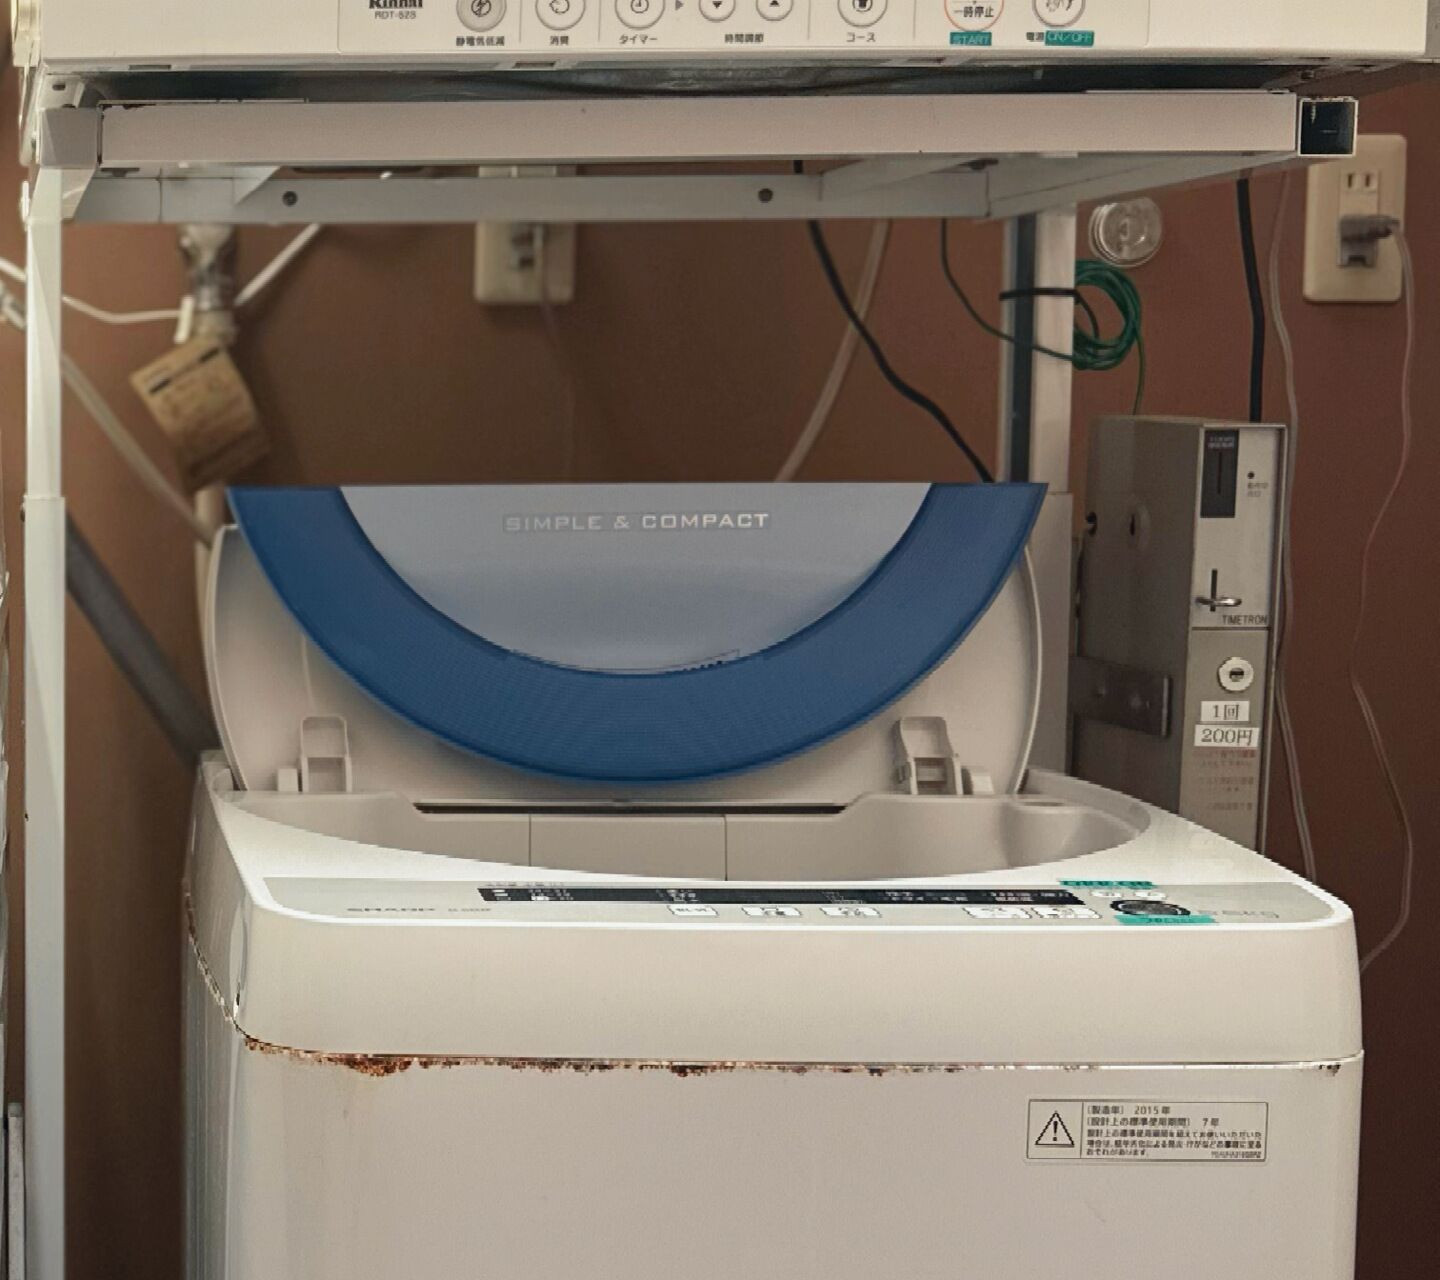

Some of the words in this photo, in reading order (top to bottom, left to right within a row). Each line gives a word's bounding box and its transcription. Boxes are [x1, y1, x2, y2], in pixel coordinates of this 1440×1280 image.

[954, 5, 999, 20] 一時停止
[619, 33, 658, 45] タイマー
[846, 31, 876, 43] コース
[953, 34, 990, 46] START
[1046, 32, 1093, 45] ON/OFF
[503, 513, 603, 533] SIMPLE
[612, 513, 632, 533] &
[640, 511, 771, 530] COMPACT
[1221, 613, 1269, 627] TIMETRON
[1213, 704, 1240, 721] 1回
[1200, 726, 1255, 747] 200円
